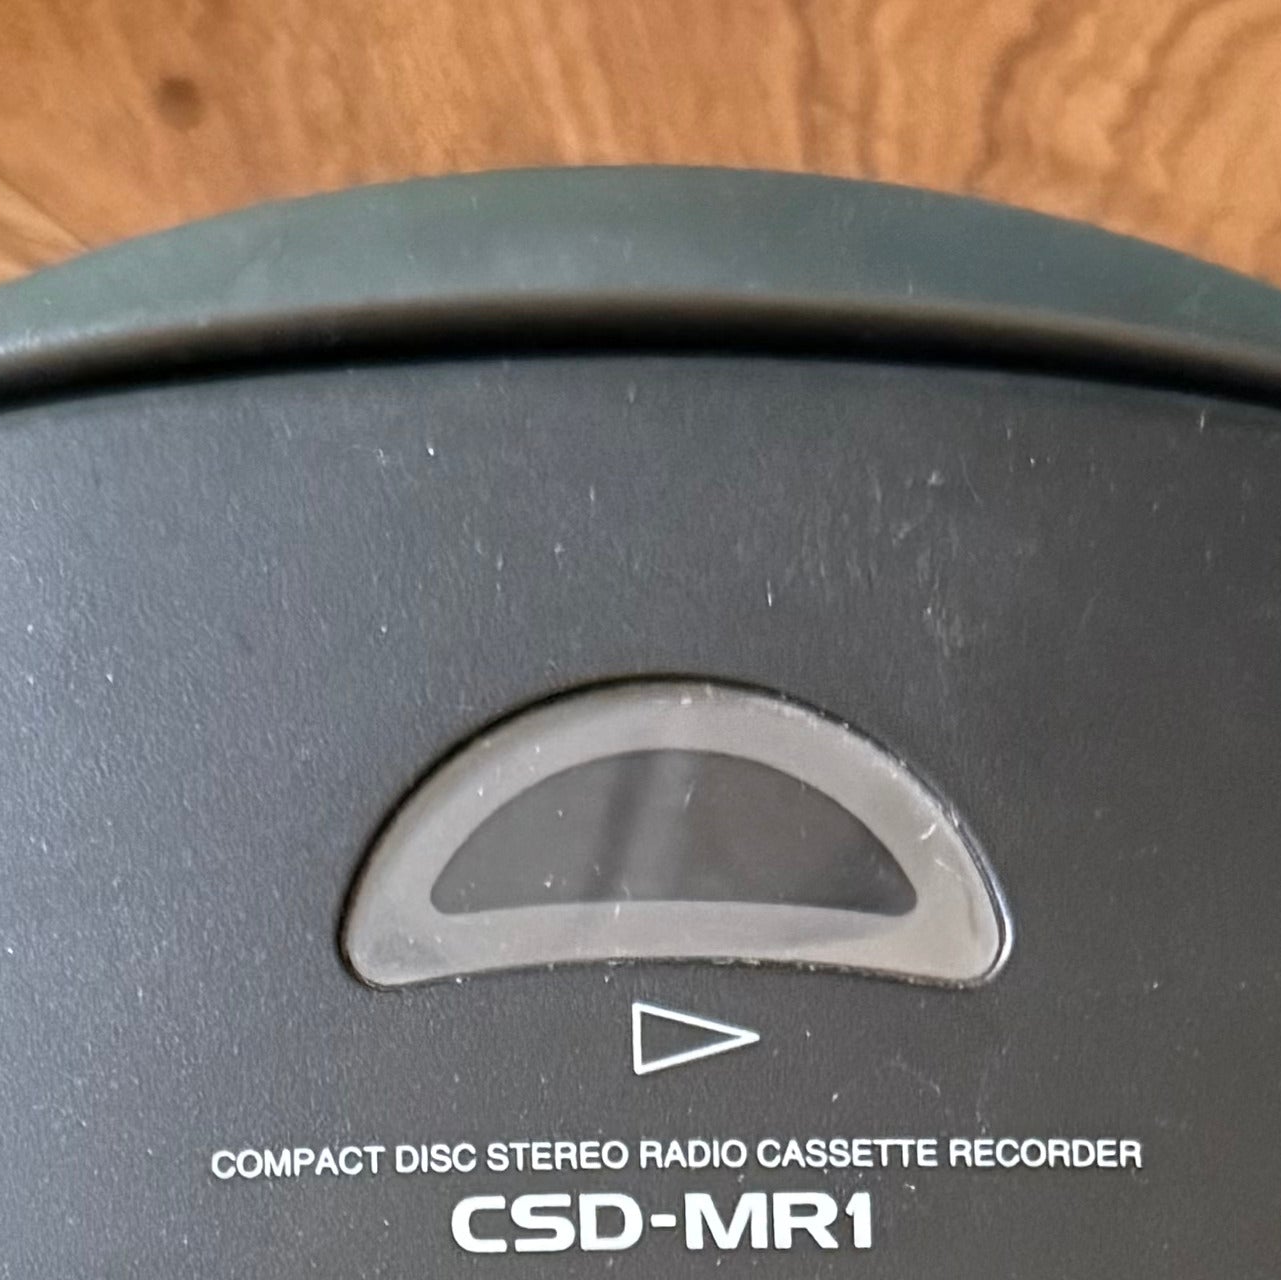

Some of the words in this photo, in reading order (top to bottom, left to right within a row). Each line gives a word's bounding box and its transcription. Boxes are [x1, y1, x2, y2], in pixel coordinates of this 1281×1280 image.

[210, 1146, 386, 1180] COMPACT
[394, 1144, 477, 1175] DISC
[486, 1142, 630, 1173] STEREO
[639, 1140, 748, 1171] RADIO
[756, 1138, 938, 1170] CASSETTE
[949, 1138, 1142, 1169] RECORDER
[450, 1192, 874, 1255] CSD-MR1
